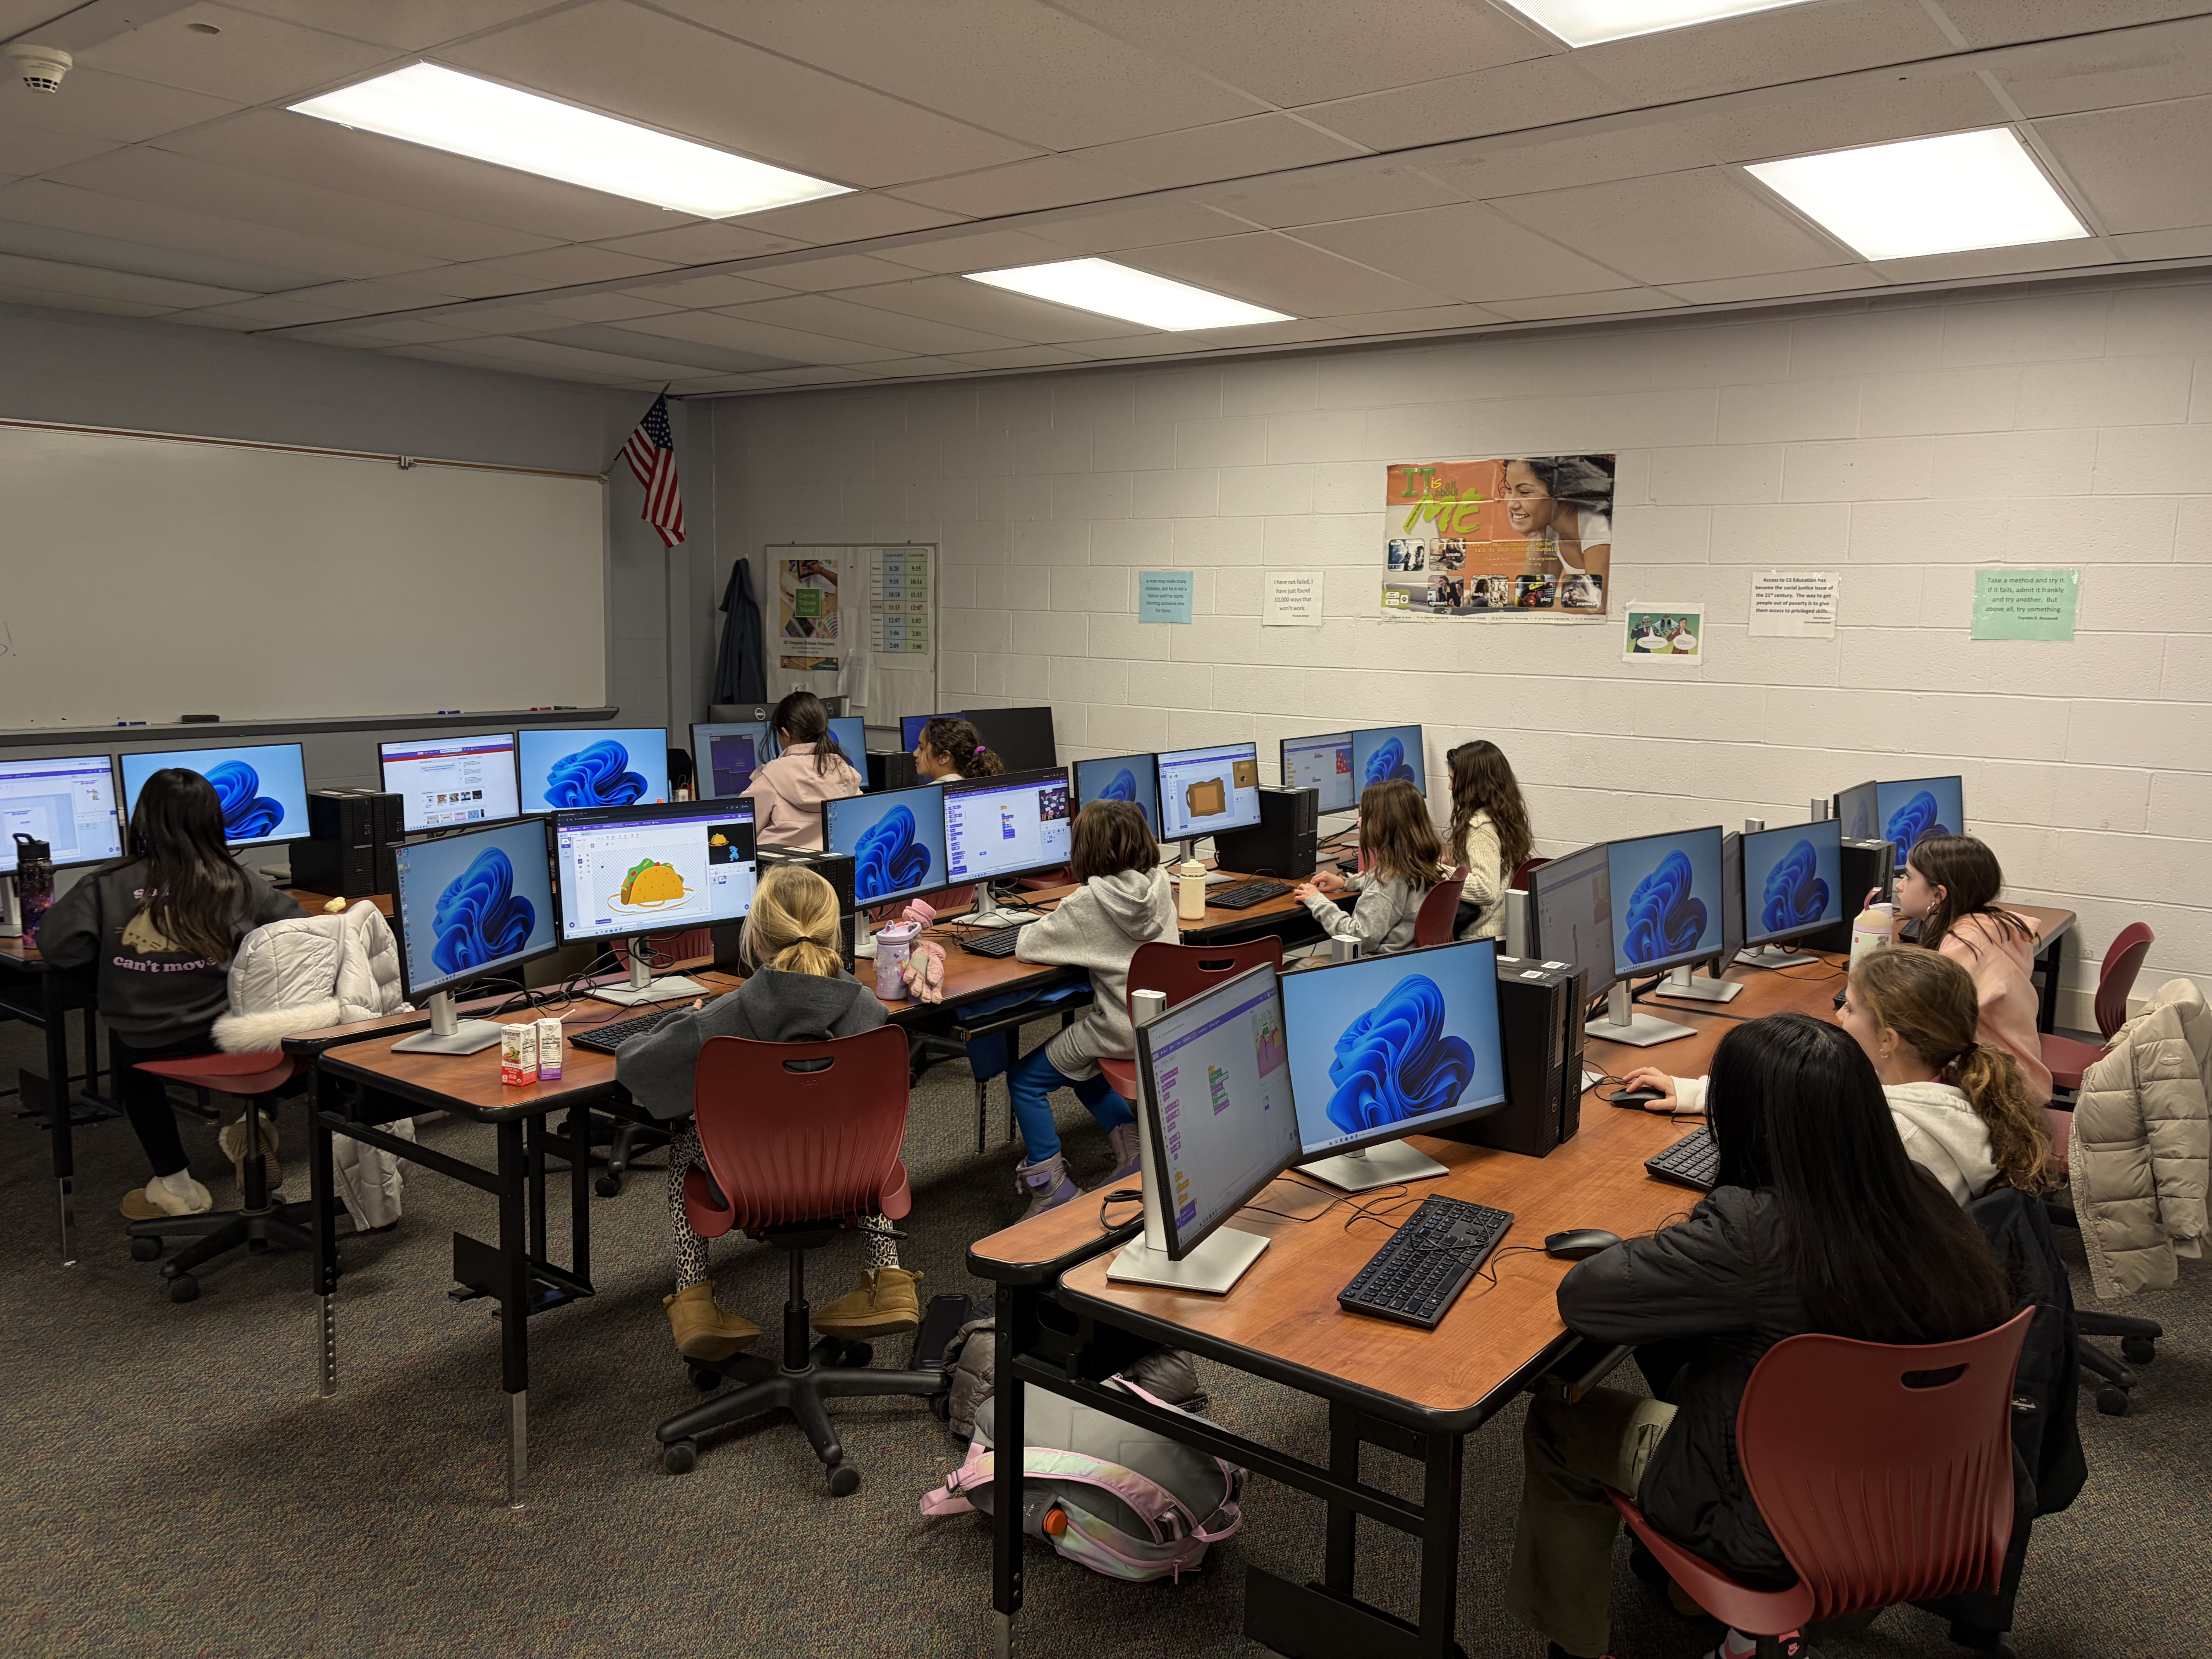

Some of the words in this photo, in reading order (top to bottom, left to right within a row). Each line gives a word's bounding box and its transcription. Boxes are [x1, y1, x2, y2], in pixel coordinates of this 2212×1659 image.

[1401, 467, 1436, 497] IT
[1431, 477, 1441, 489] is
[1445, 481, 1456, 489] all
[1435, 489, 1459, 497] about
[1403, 488, 1486, 534] ME
[113, 957, 160, 972] can't
[163, 957, 217, 972] move
